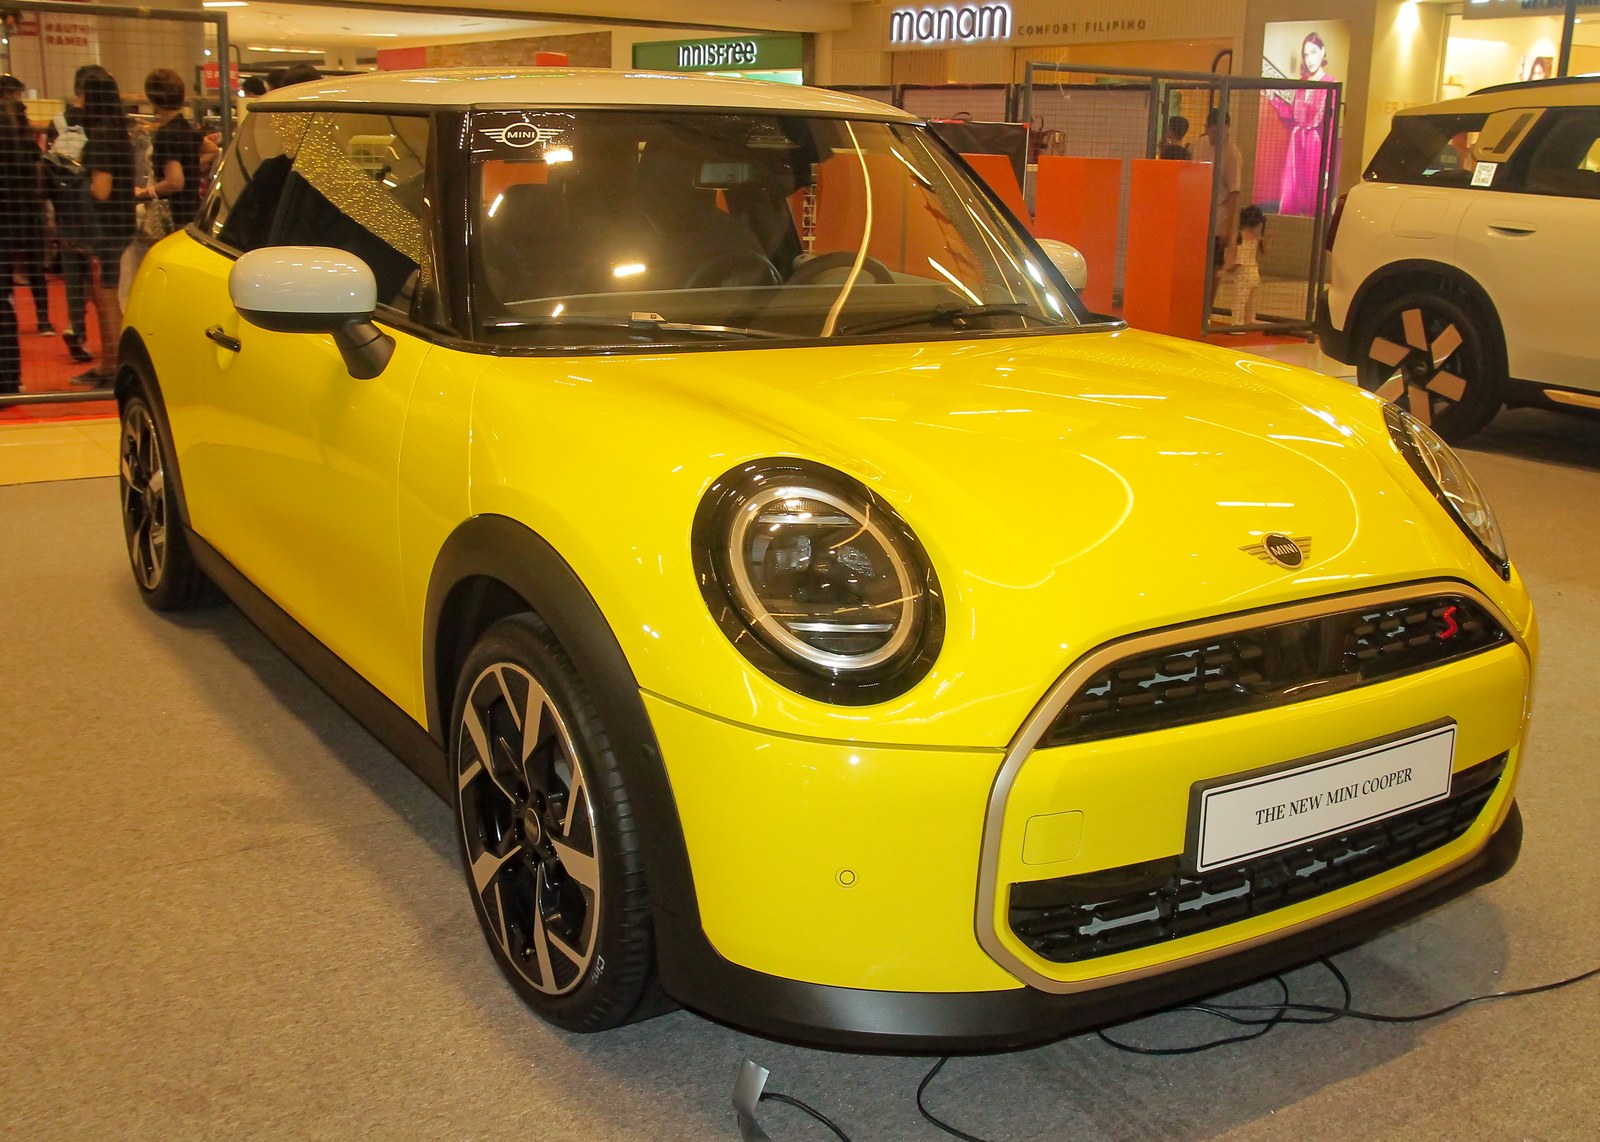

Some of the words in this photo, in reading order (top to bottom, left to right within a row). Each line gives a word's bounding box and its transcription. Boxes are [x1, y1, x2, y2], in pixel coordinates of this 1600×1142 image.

[889, 4, 1009, 42] manam
[1017, 22, 1077, 36] COMFORT
[1085, 19, 1147, 33] FILIPINO
[506, 131, 535, 139] MINI
[1270, 543, 1298, 556] MINI
[1439, 605, 1457, 639] S
[1255, 804, 1287, 825] THE
[1288, 793, 1325, 817] NEW
[1325, 783, 1360, 807] MINI
[1361, 767, 1413, 795] COOPER
